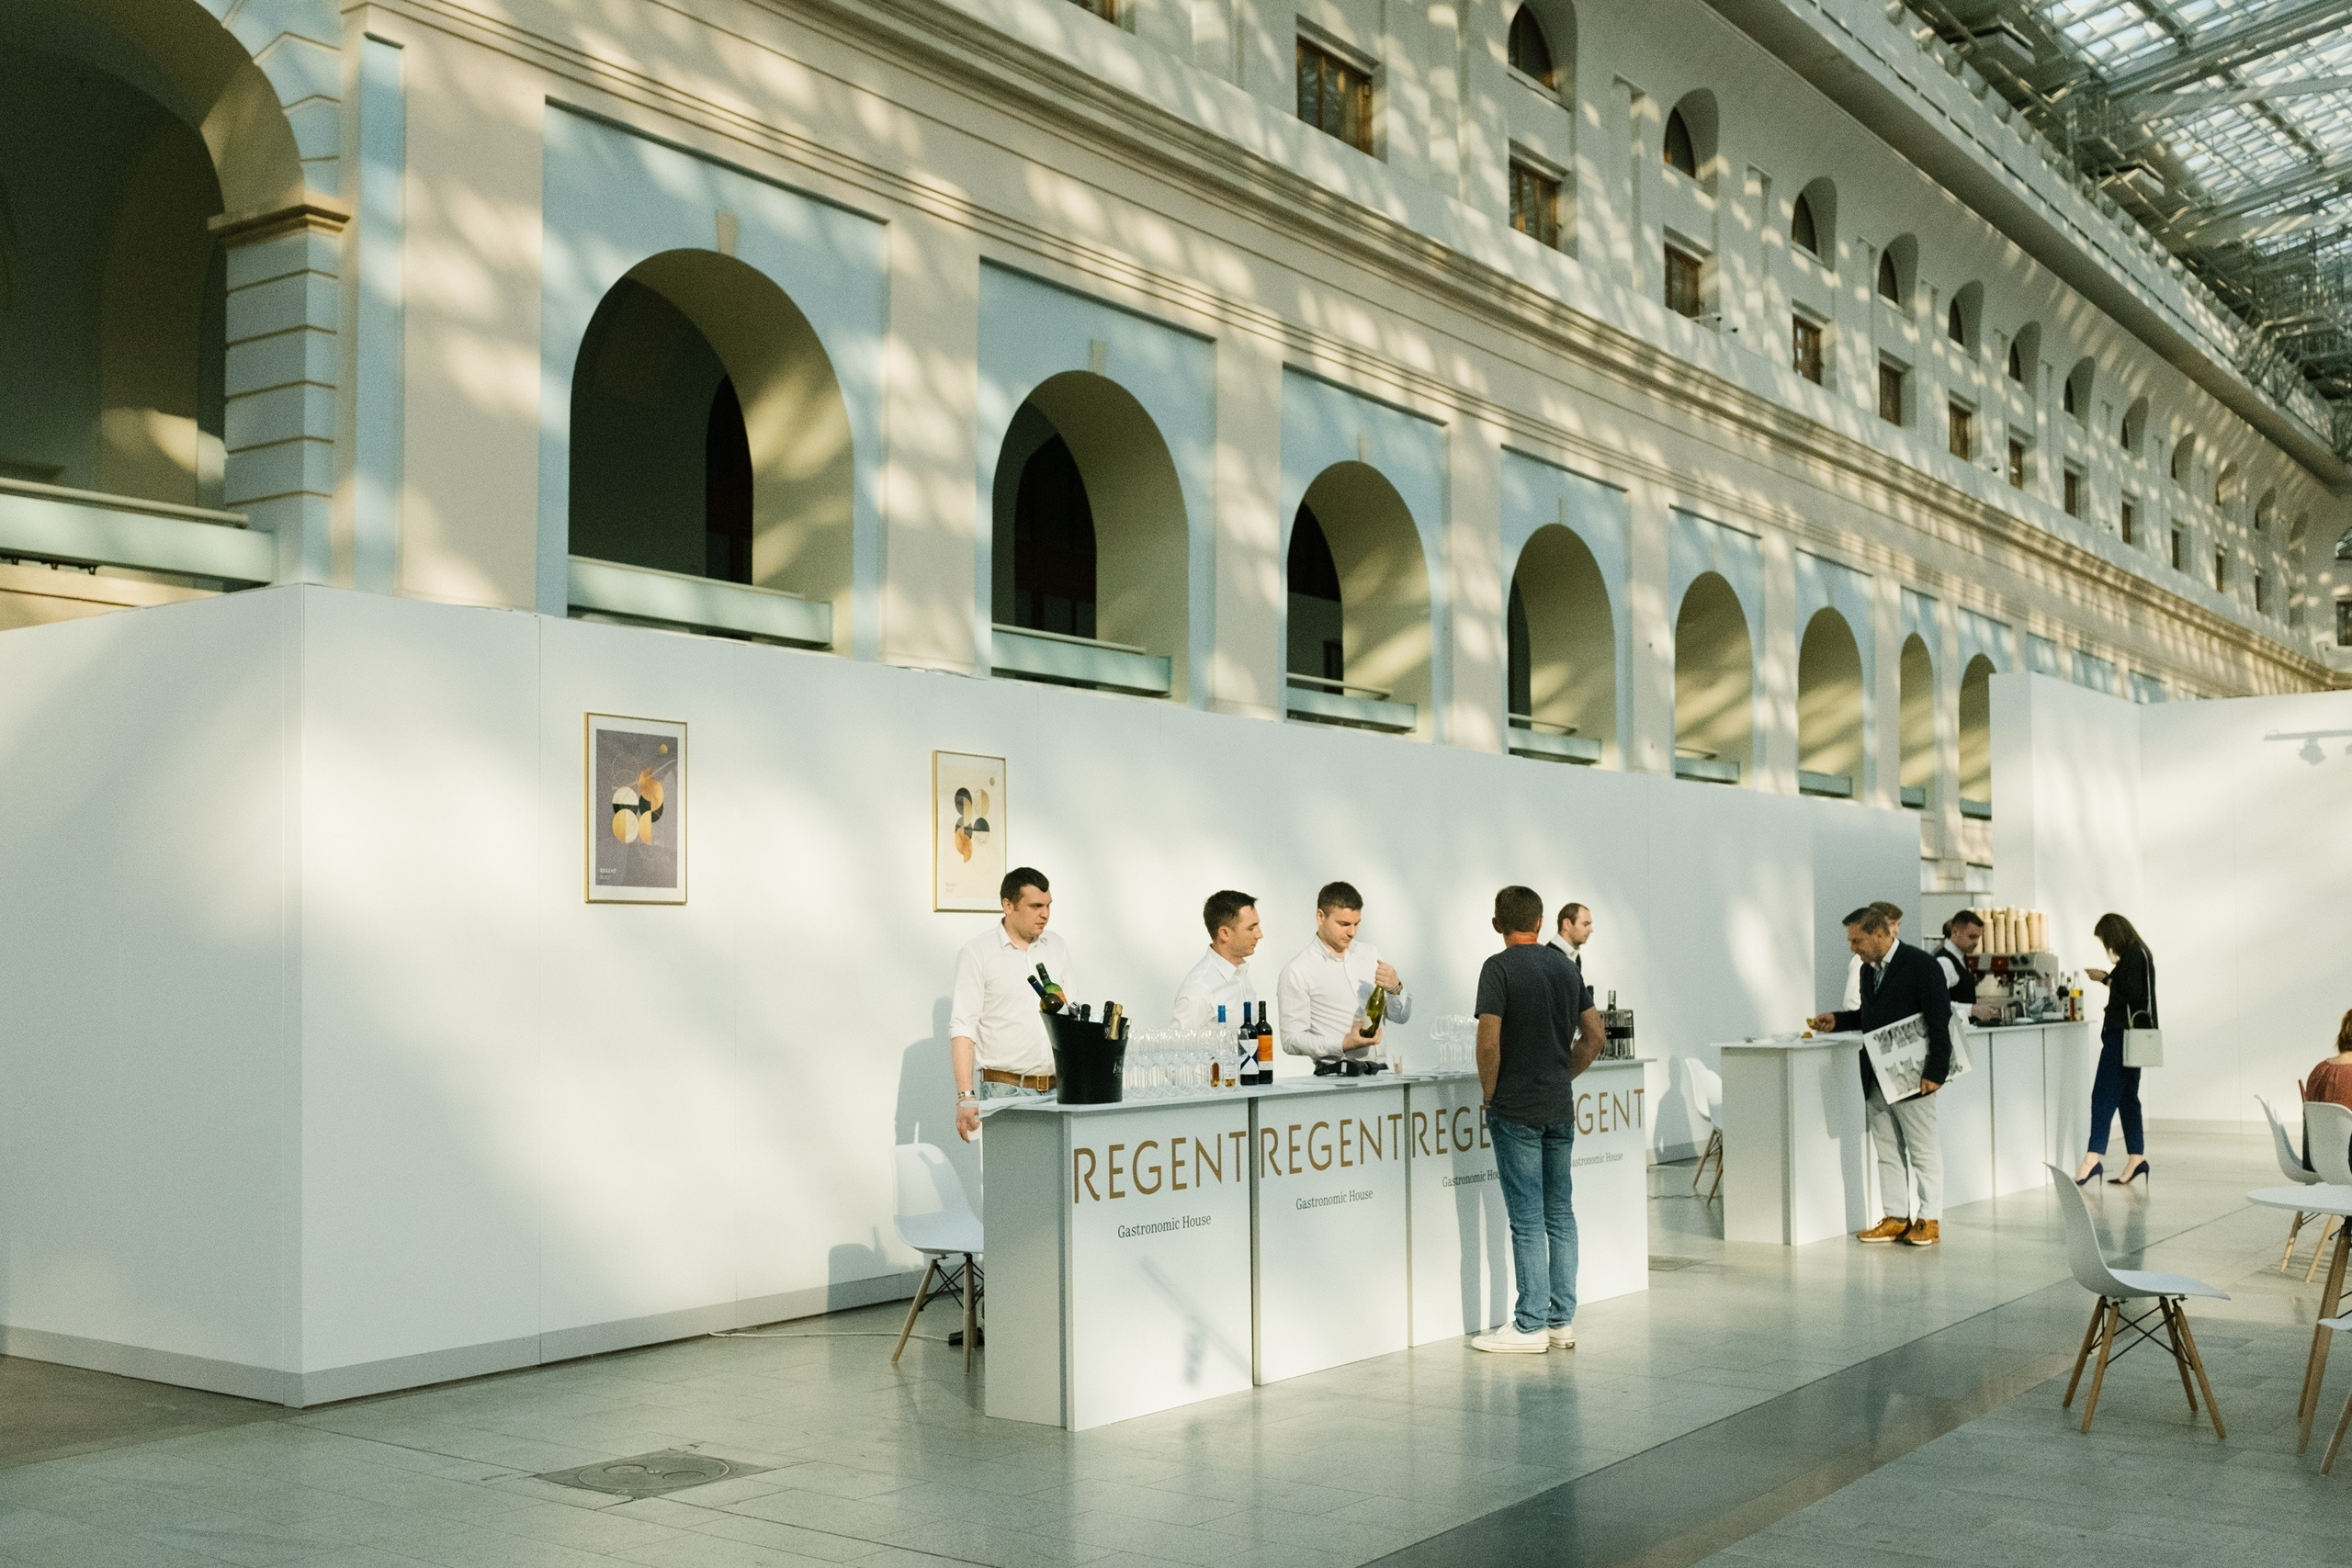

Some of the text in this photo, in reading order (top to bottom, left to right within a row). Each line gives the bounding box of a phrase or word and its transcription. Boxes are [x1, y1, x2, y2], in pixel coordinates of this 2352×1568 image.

[1576, 1089, 1645, 1134] GENT
[1261, 1113, 1403, 1179] REGENT
[1412, 1105, 1491, 1157] REGE
[1074, 1131, 1247, 1204] REGENT
[1572, 1152, 1623, 1167] astronomic House
[1442, 1170, 1487, 1187] Gastronomic
[1295, 1190, 1374, 1210] Gastronomic House
[1117, 1214, 1212, 1238] Gastronomic House
